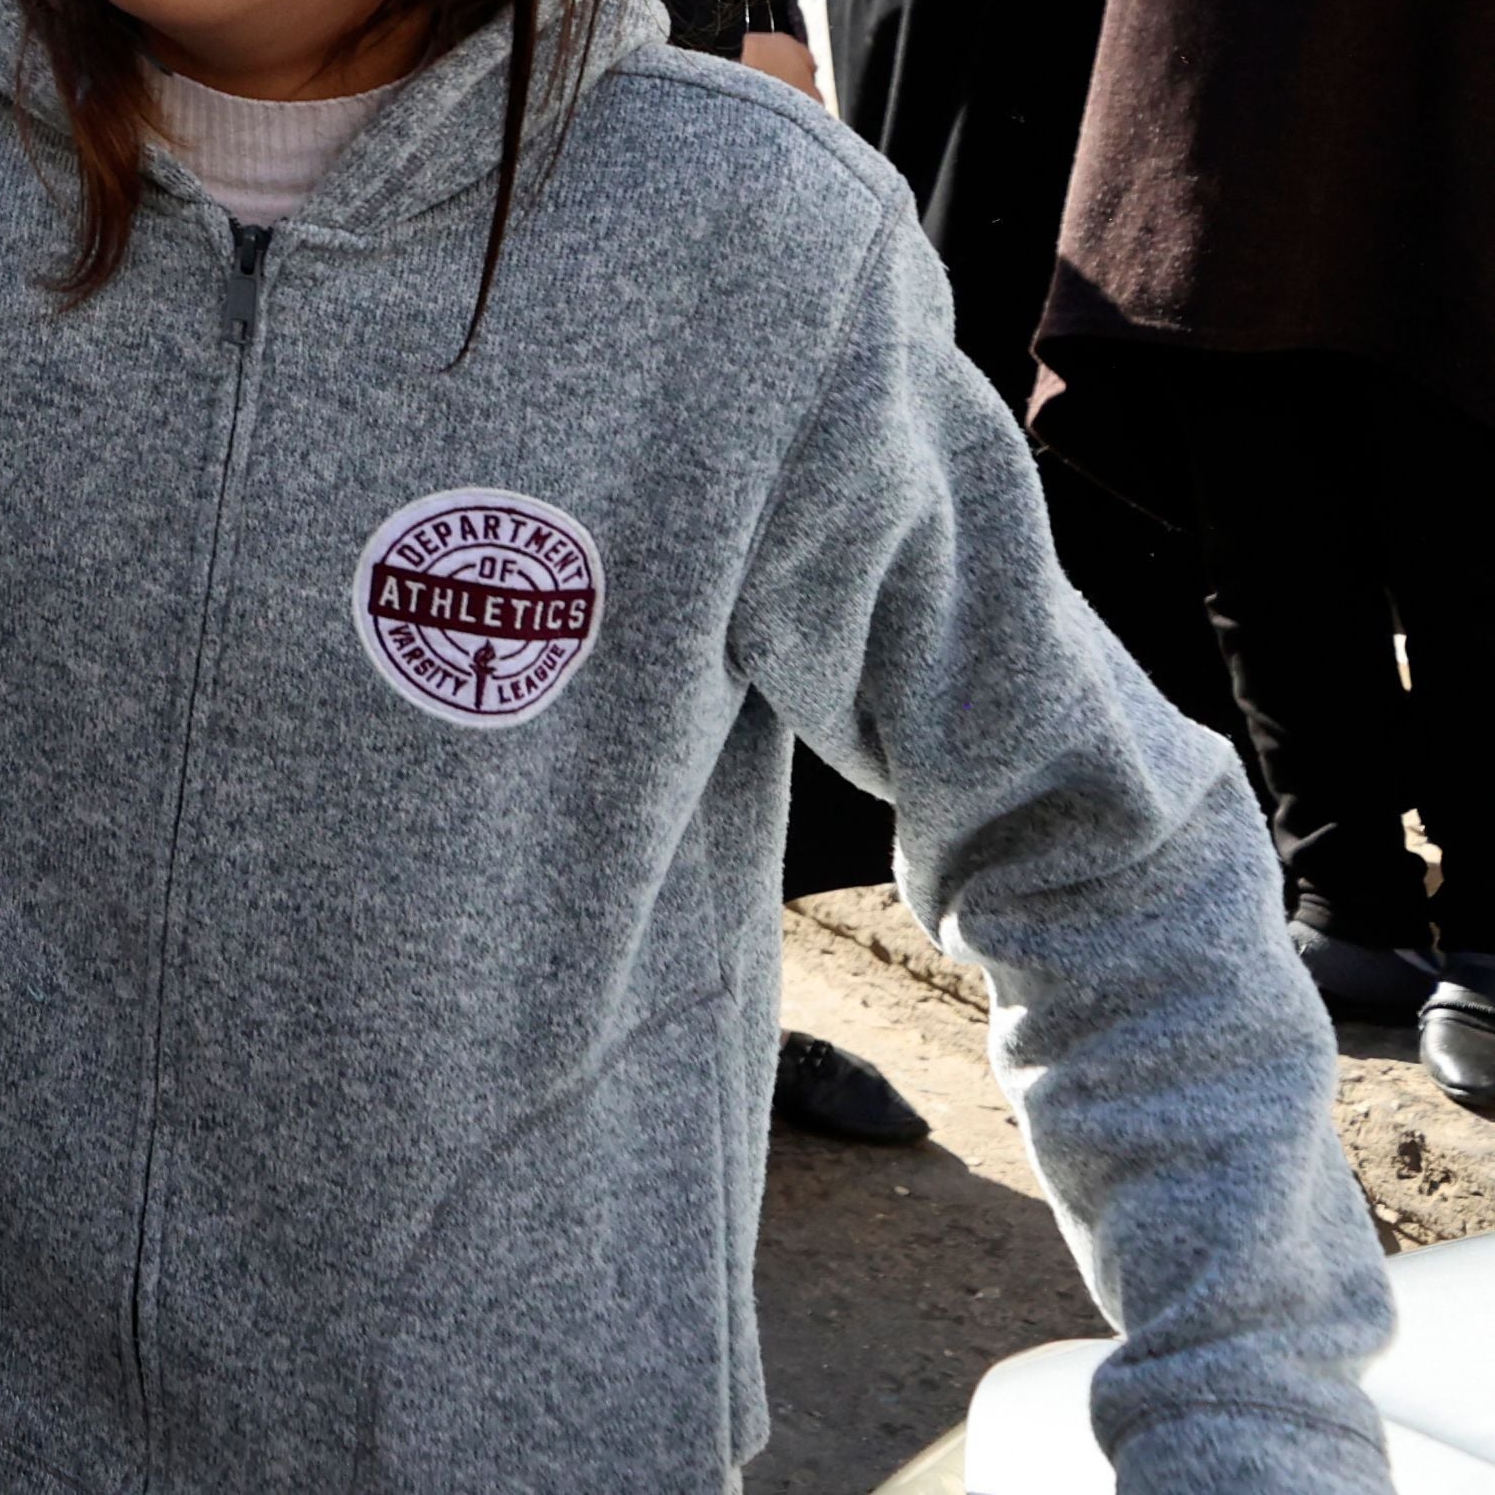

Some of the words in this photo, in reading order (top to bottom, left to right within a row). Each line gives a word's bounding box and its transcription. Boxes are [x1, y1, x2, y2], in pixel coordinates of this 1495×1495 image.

[396, 514, 585, 584] DEPARTMENT
[478, 556, 517, 583] OF
[377, 574, 587, 631] ATHLETICS
[387, 624, 470, 697] VARSITY
[497, 643, 566, 704] LEAGUE
